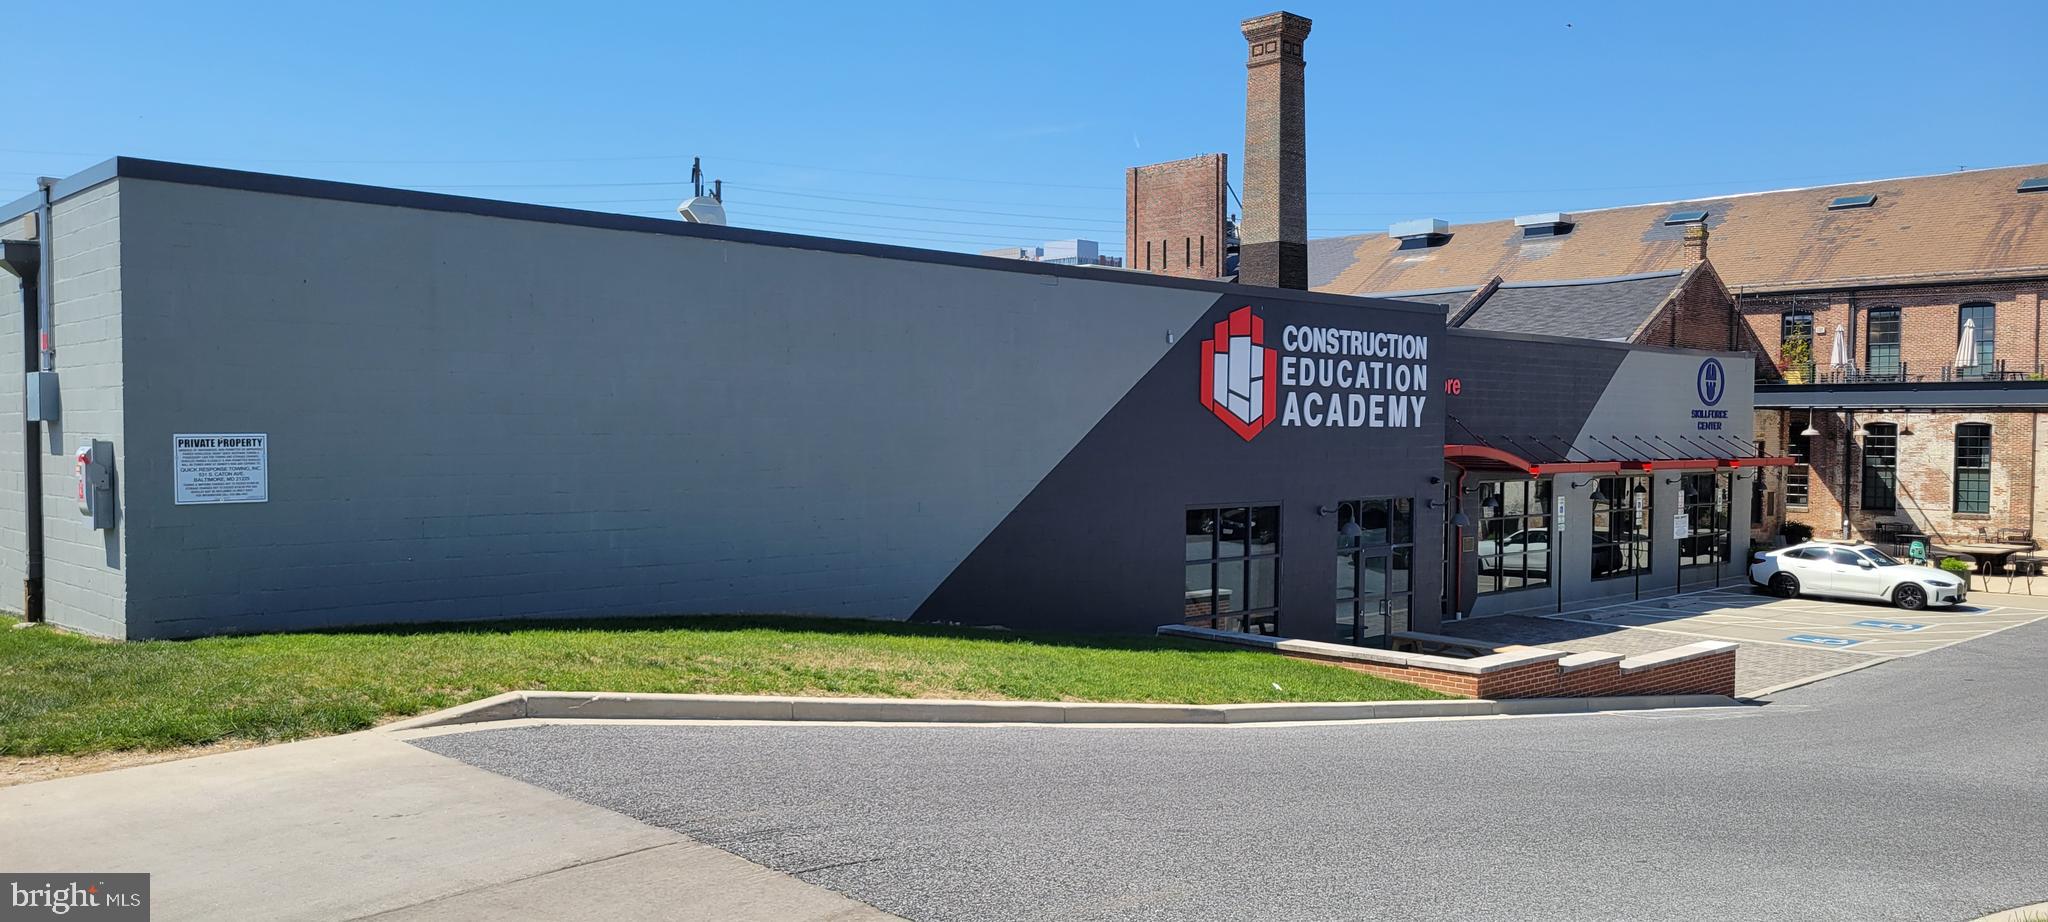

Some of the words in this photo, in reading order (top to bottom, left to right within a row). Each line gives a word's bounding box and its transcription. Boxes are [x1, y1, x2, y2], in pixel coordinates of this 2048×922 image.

[1282, 325, 1428, 360] CONSTRUCTION
[1281, 356, 1428, 392] EDUCATION
[1281, 391, 1427, 428] ACADEMY
[1691, 410, 1729, 418] SKILLFORCE
[1697, 421, 1722, 430] CENTER
[178, 439, 215, 448] PRIVATE
[217, 438, 263, 447] PROPERTY
